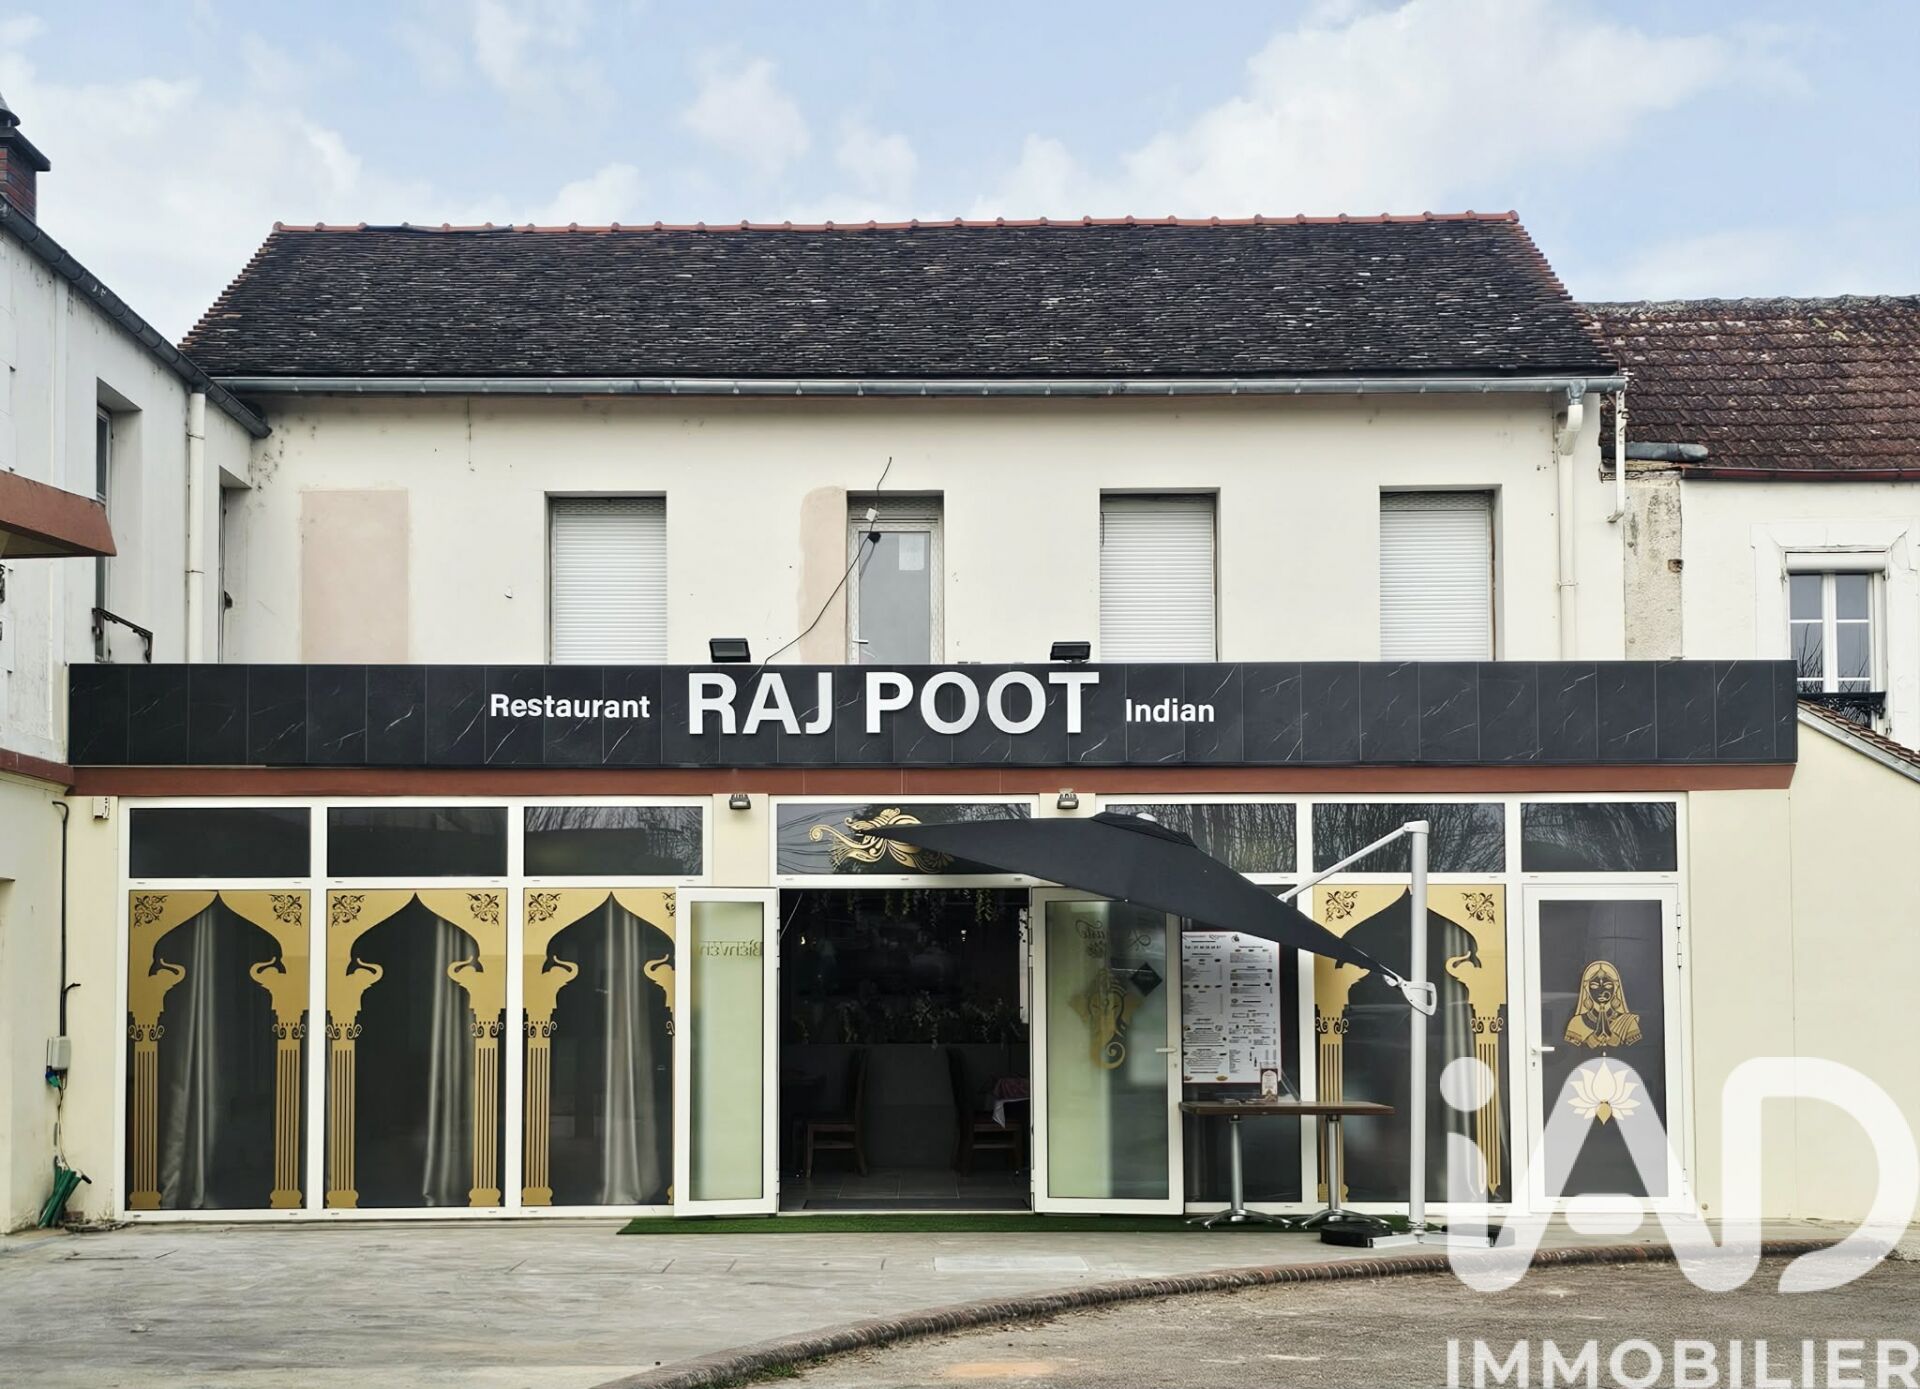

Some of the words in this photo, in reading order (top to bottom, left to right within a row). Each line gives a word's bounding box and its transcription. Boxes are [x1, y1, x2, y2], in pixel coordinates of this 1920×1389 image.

[489, 692, 652, 720] Restaurant
[687, 671, 834, 736] RAJ
[865, 670, 1101, 735] POOT
[1125, 696, 1216, 724] Indian
